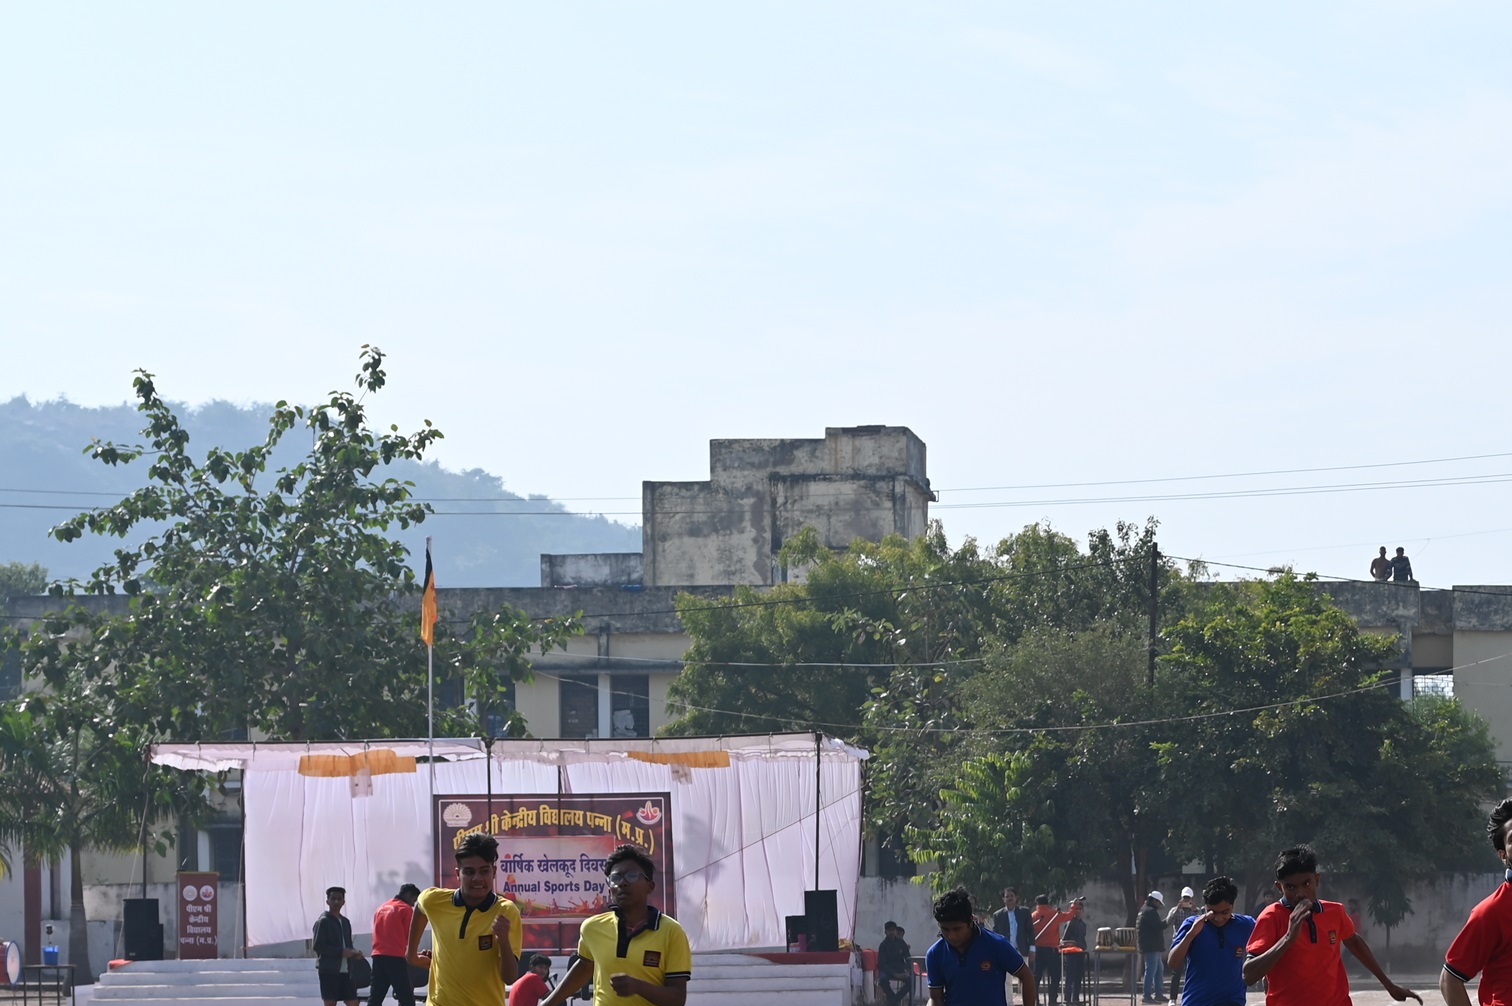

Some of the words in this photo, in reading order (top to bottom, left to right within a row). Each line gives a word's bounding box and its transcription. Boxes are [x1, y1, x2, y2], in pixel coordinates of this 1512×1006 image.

[453, 824, 483, 850] पी
[586, 811, 613, 832] पन्ना
[500, 853, 534, 873] वार्षिक
[537, 853, 577, 878] खेलकूद
[503, 881, 541, 893] Annual
[544, 880, 581, 895] Sports
[584, 880, 605, 894] Day
